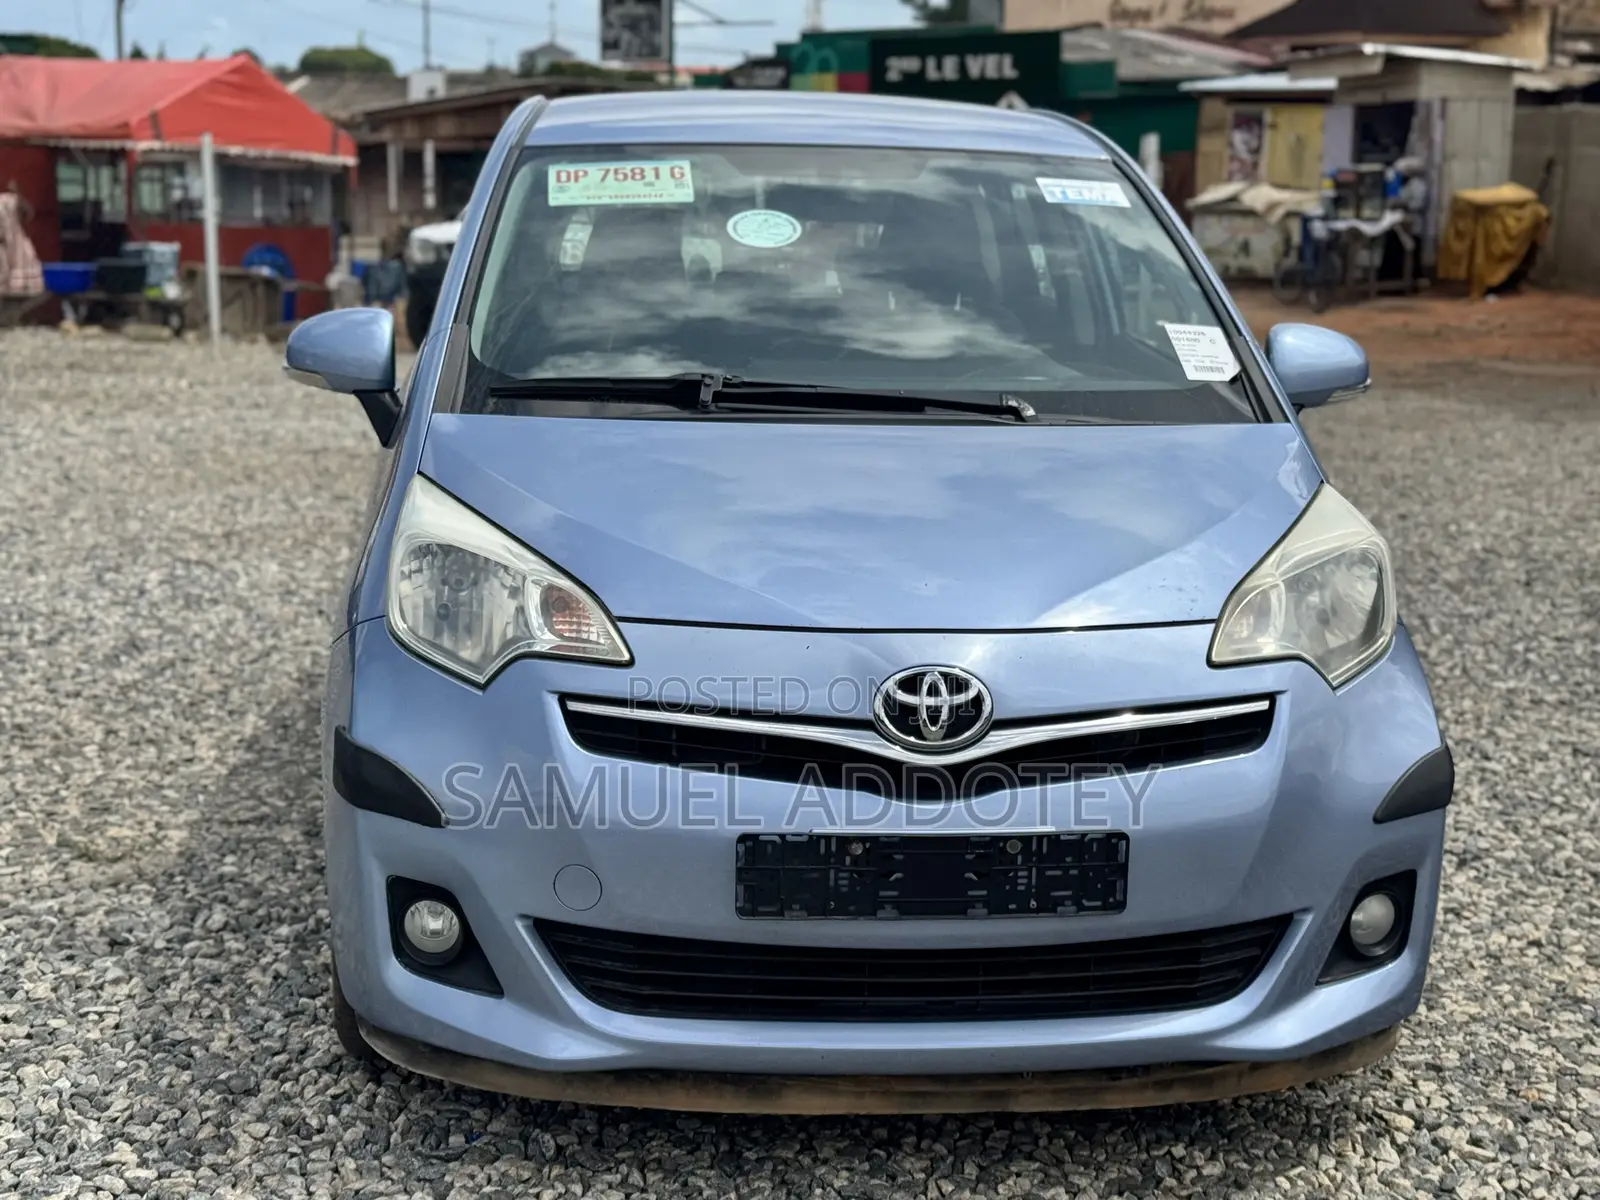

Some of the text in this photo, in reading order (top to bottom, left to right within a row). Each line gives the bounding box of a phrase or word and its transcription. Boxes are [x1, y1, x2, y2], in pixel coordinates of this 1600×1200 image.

[555, 165, 686, 184] DP 7581 G
